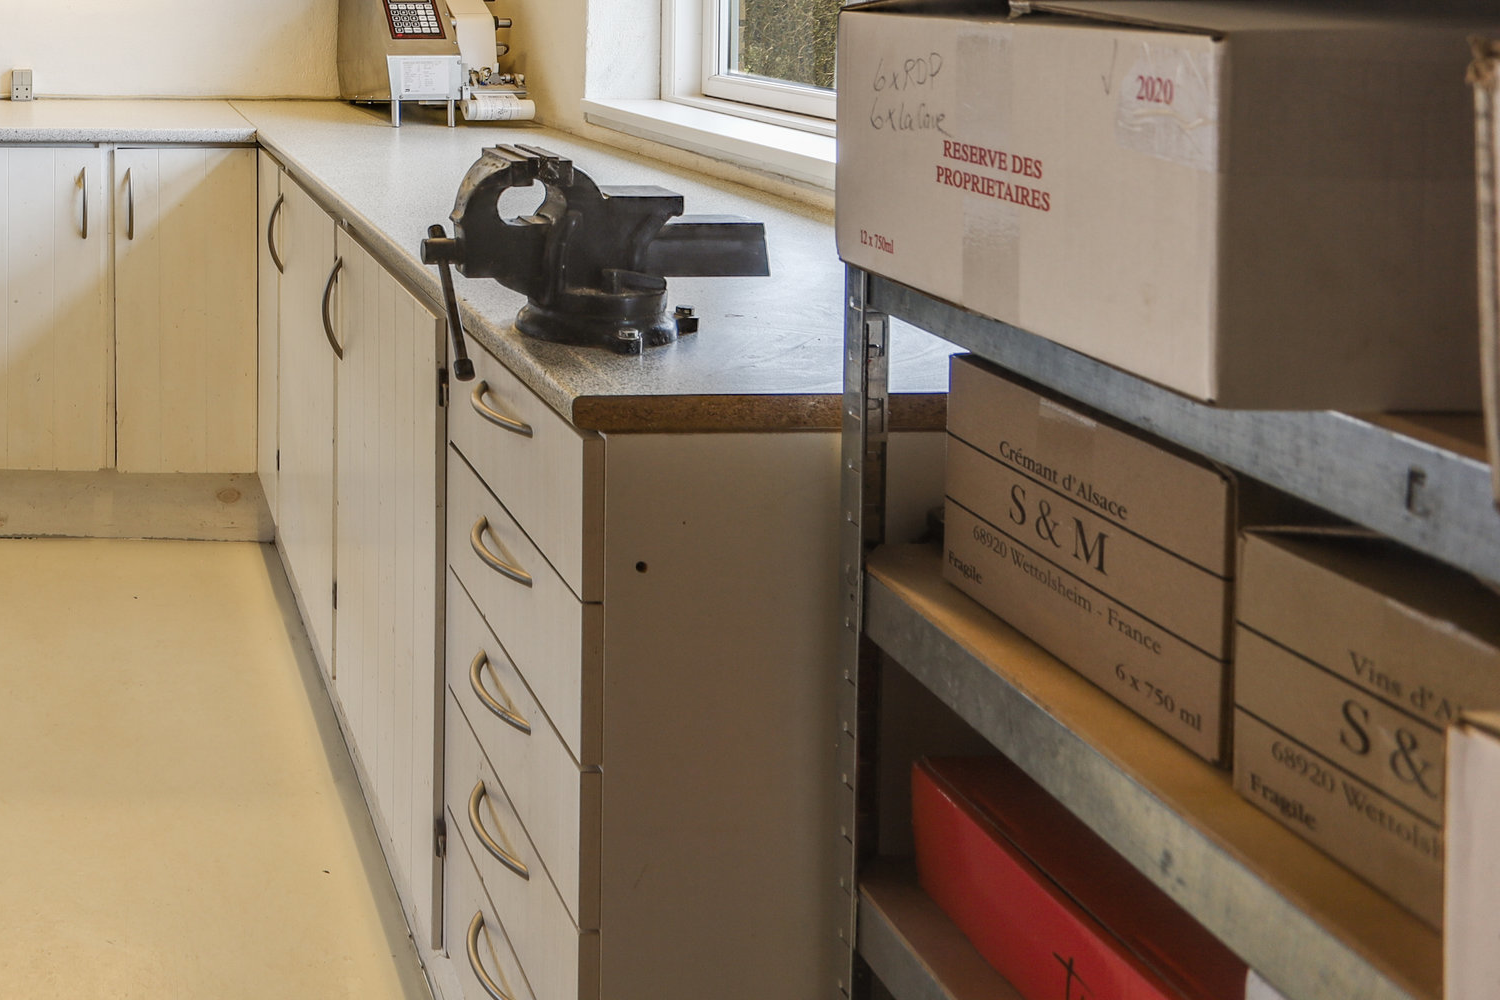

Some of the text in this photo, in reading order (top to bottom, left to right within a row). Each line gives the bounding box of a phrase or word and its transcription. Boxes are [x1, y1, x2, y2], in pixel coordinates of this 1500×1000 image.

[1136, 74, 1175, 105] 2020
[943, 140, 1043, 180] RESERVE DES
[936, 165, 1051, 212] PROPRIETAIRES
[860, 229, 867, 244] 12
[874, 233, 894, 254] 750ml
[1000, 440, 1128, 521] Crémant d'Alsace
[1009, 483, 1109, 577] S & M
[948, 549, 983, 586] Fragile
[972, 524, 1008, 559] 68920
[1010, 546, 1093, 614] Wettolsheim
[1107, 606, 1163, 656] France
[1115, 662, 1202, 732] 6 x 750 ml
[1348, 649, 1401, 697] Vins
[1271, 740, 1335, 793] 68920
[1340, 700, 1438, 800] S &
[1250, 773, 1318, 832] Fragile
